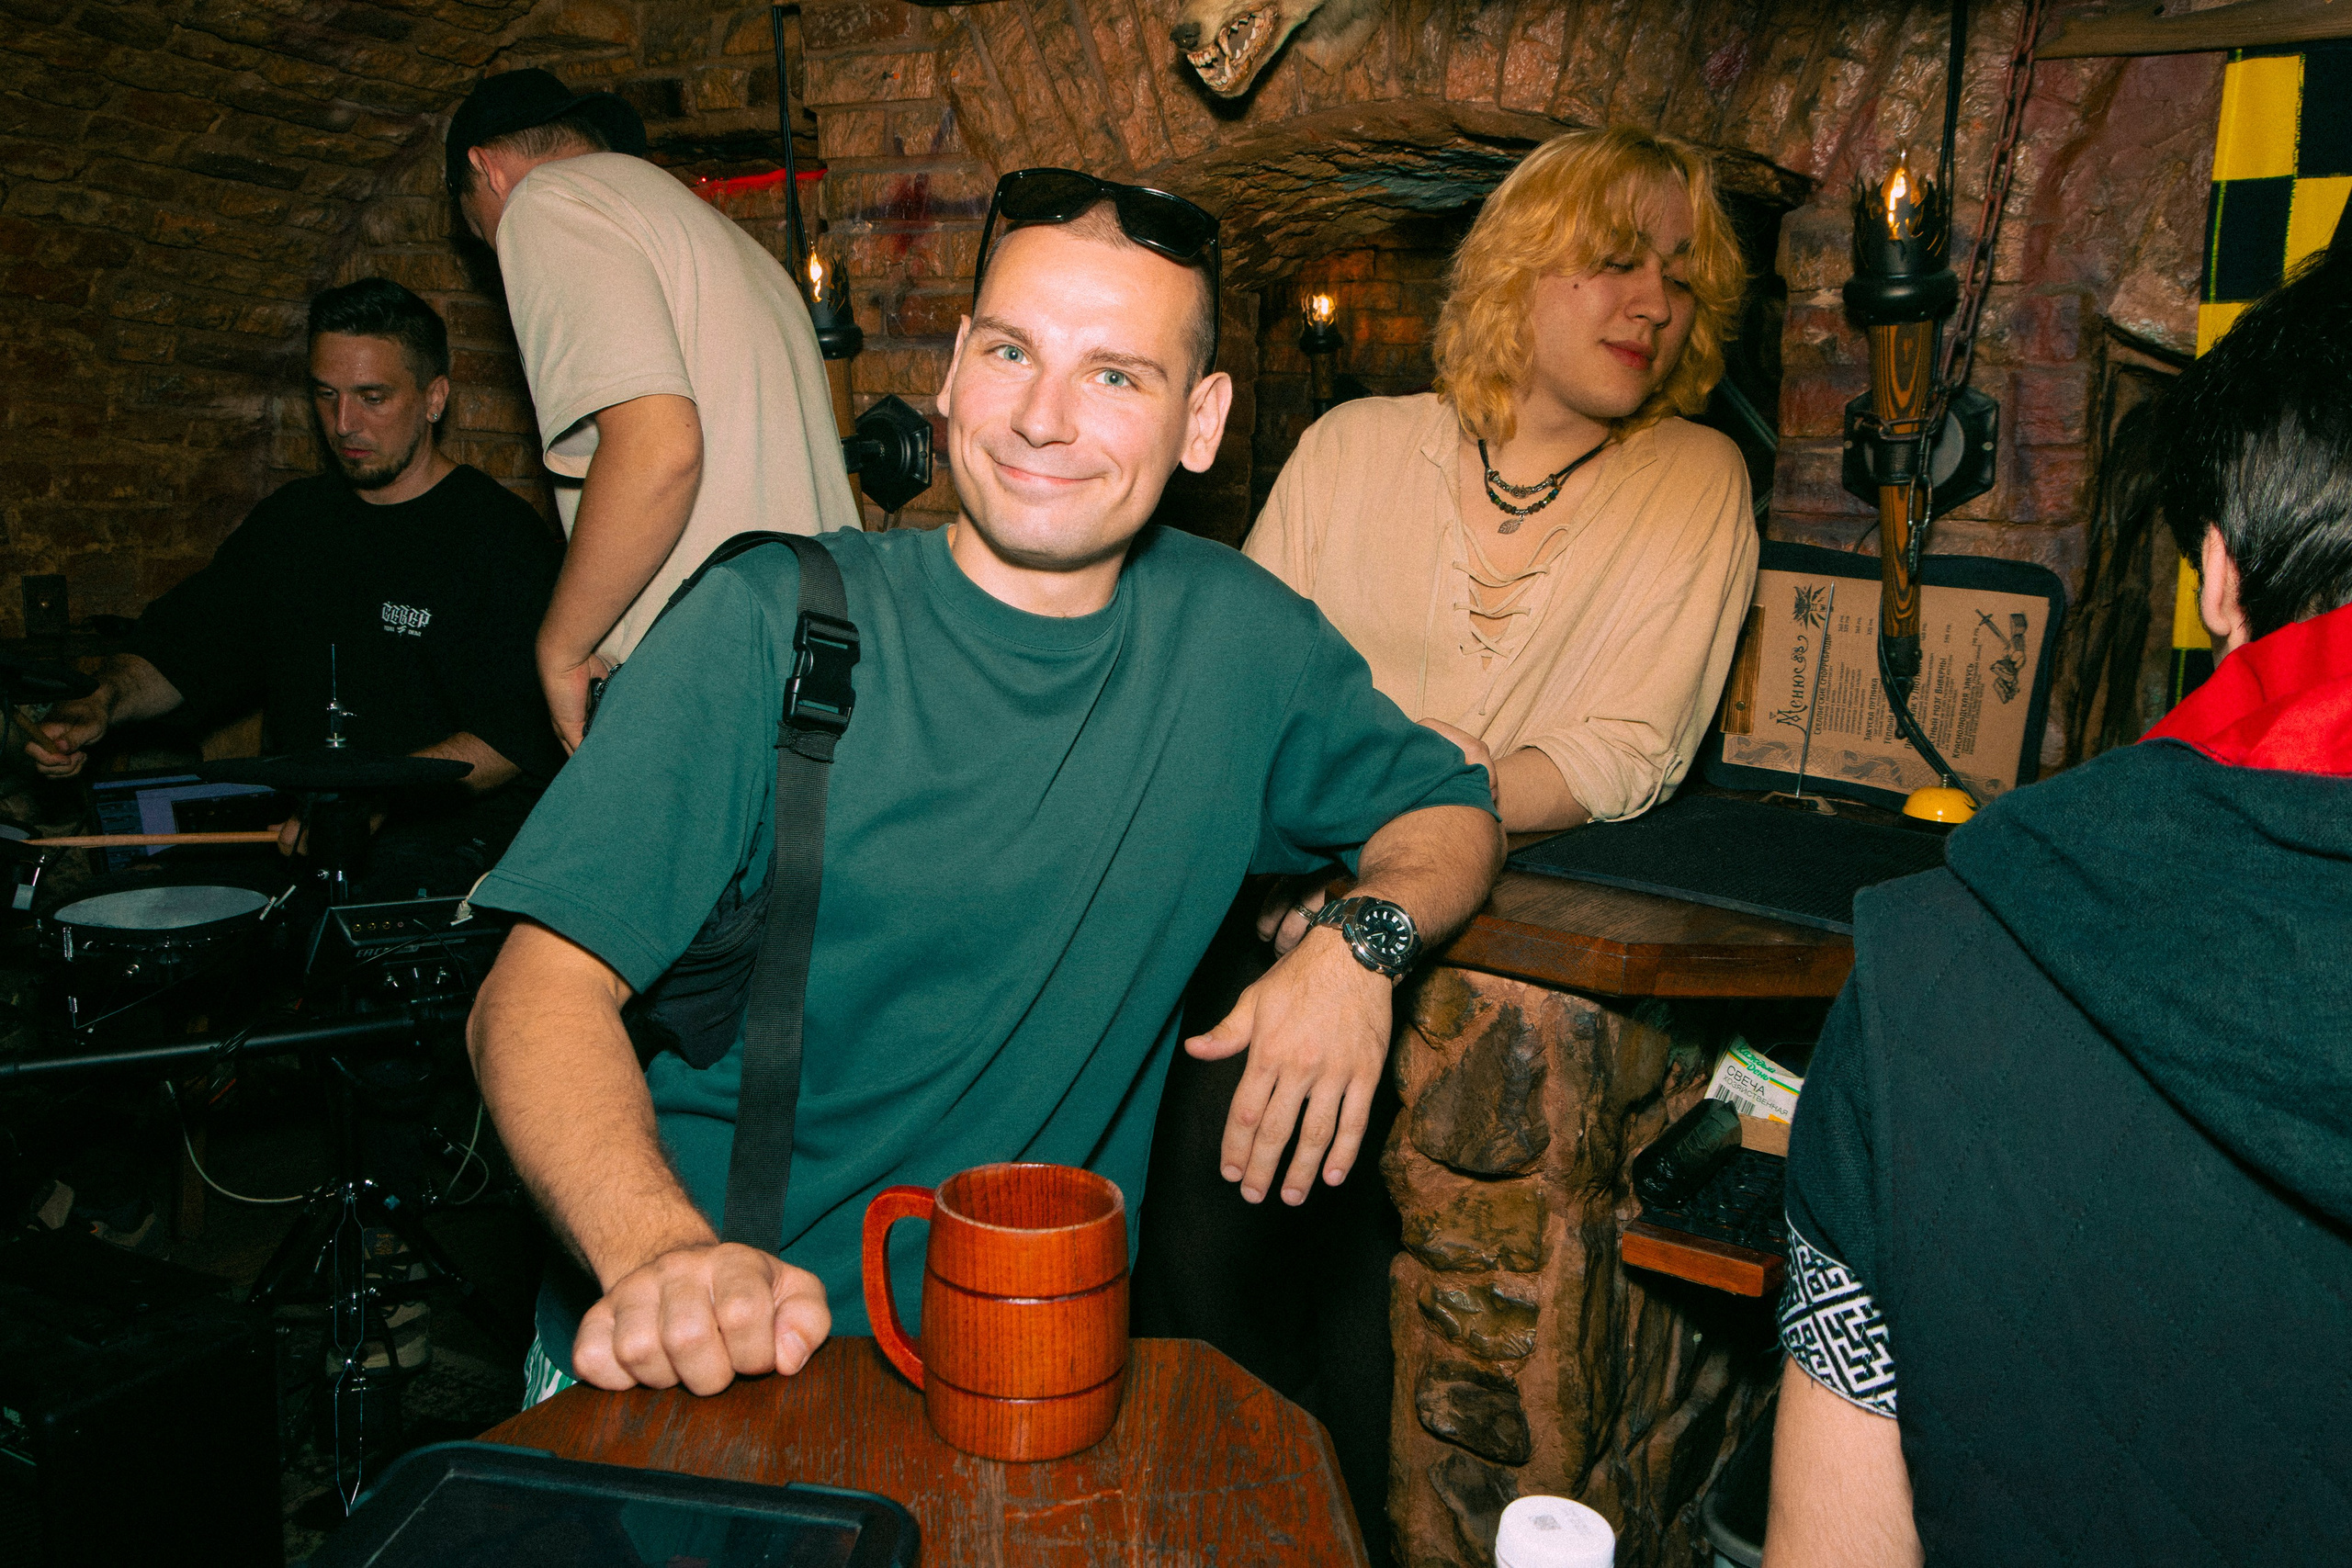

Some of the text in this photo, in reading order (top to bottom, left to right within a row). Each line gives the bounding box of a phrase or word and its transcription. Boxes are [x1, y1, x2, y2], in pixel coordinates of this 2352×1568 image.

[1726, 1065, 1766, 1096] СВЕЧА
[1747, 1062, 1770, 1081] День
[1723, 1074, 1789, 1116] ХОЗЯЙСТВЕННАЯ
